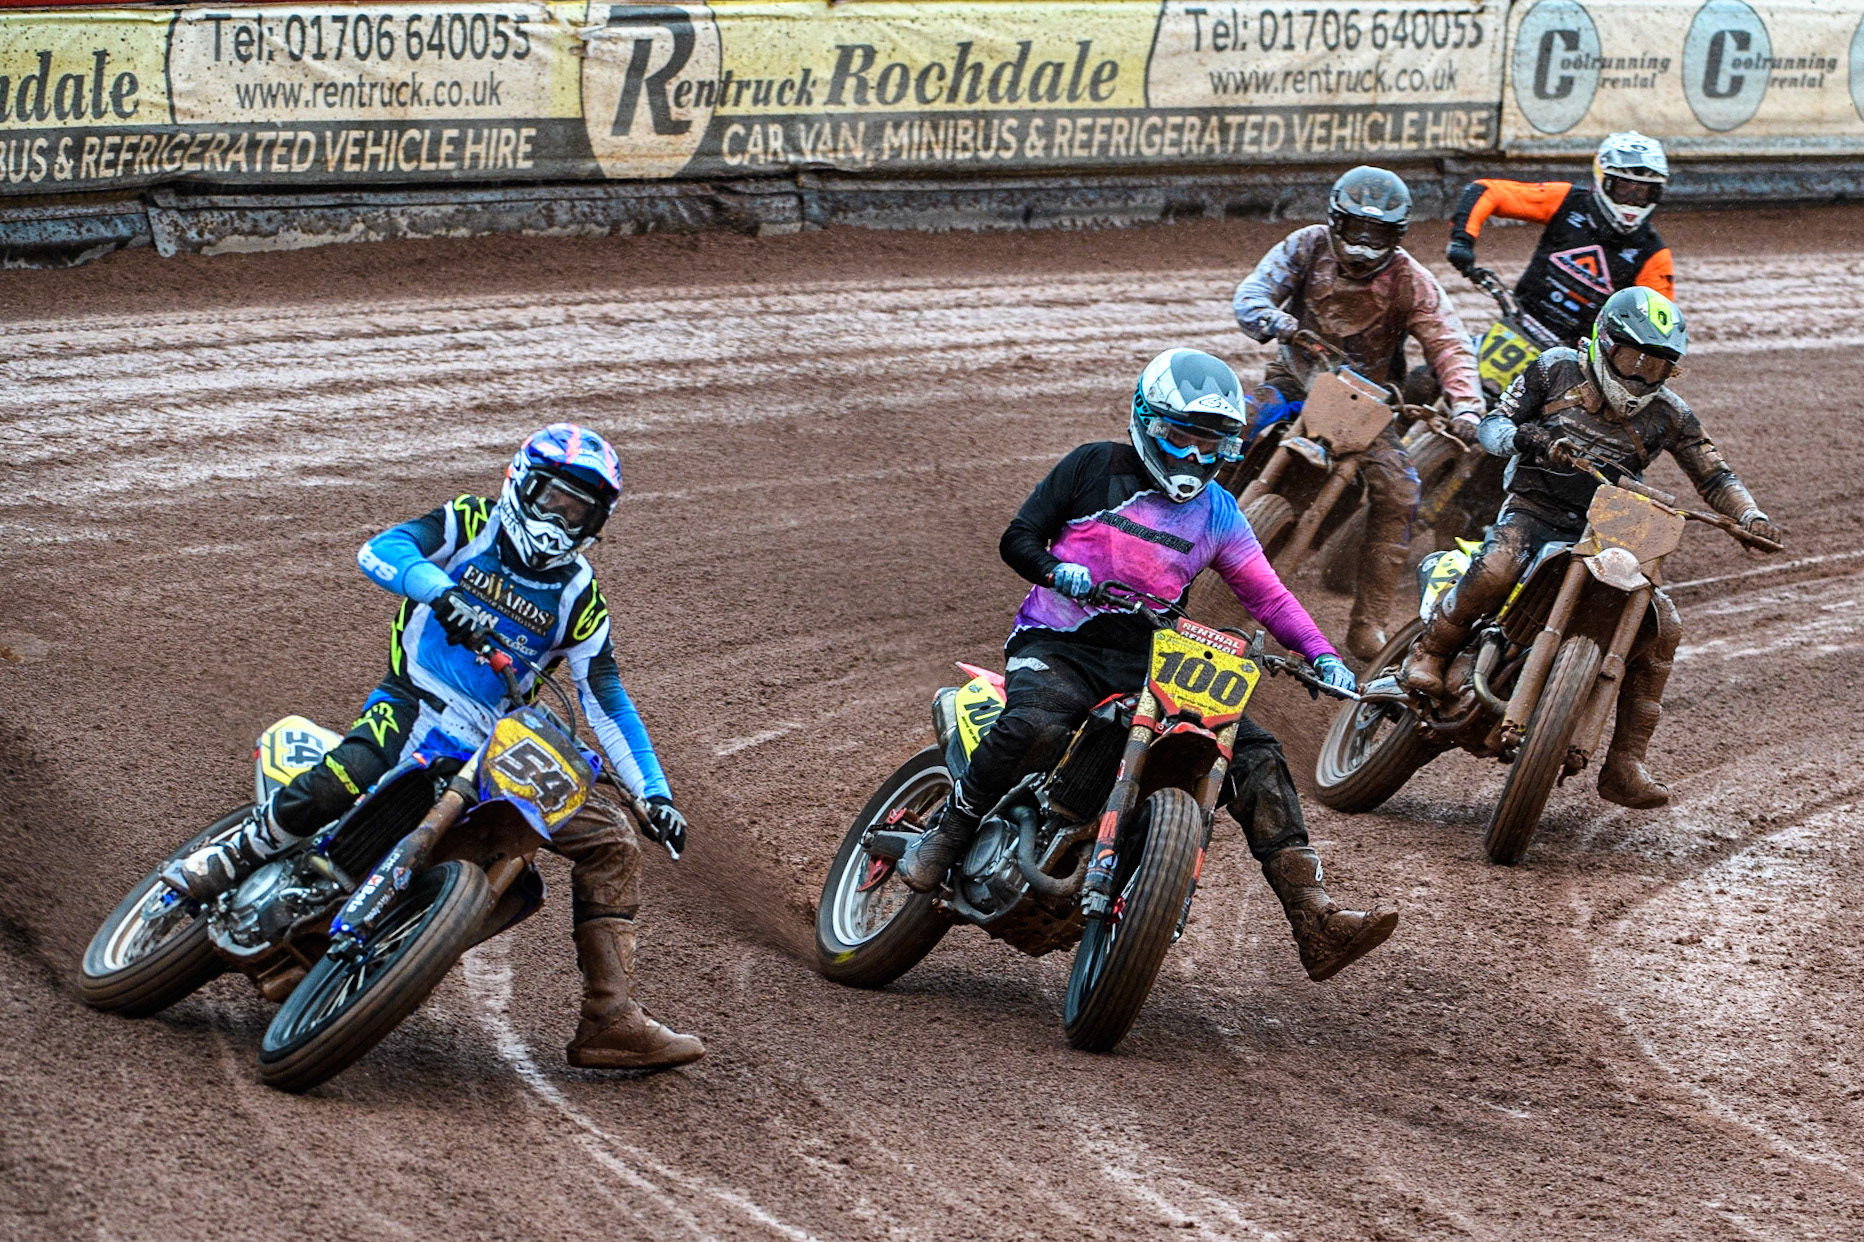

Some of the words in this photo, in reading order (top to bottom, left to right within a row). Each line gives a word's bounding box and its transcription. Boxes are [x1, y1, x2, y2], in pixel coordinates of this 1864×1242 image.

[206, 13, 274, 63] Tel:
[285, 13, 393, 62] 01706
[406, 13, 531, 61] 640055
[1185, 8, 1248, 51] Tel:
[1259, 9, 1361, 51] 01706
[1371, 6, 1485, 50] 640055
[236, 71, 502, 110] www.rentruck.co.uk
[606, 5, 817, 137] Rentruck
[824, 40, 1119, 108] Rochdale
[1209, 59, 1459, 95] www.rentruck.co.uk
[1600, 73, 1657, 90] rental
[1768, 73, 1825, 90] rental
[53, 136, 75, 182] &
[80, 129, 316, 179] REFRIGERATED
[324, 128, 461, 173] VEHICLE
[463, 127, 537, 170] HIRE
[882, 118, 1019, 161] MINIBUS
[1024, 117, 1047, 159] &
[1052, 113, 1286, 158] REFRIGERATED
[1292, 110, 1420, 153] VEHICLE
[1424, 110, 1490, 150] HIRE
[1482, 336, 1526, 372] 19
[463, 564, 551, 626] EDWARDS
[1182, 622, 1241, 649] RENTHAL
[1156, 652, 1249, 707] 100
[283, 730, 325, 767] 54
[490, 738, 578, 812] 54
